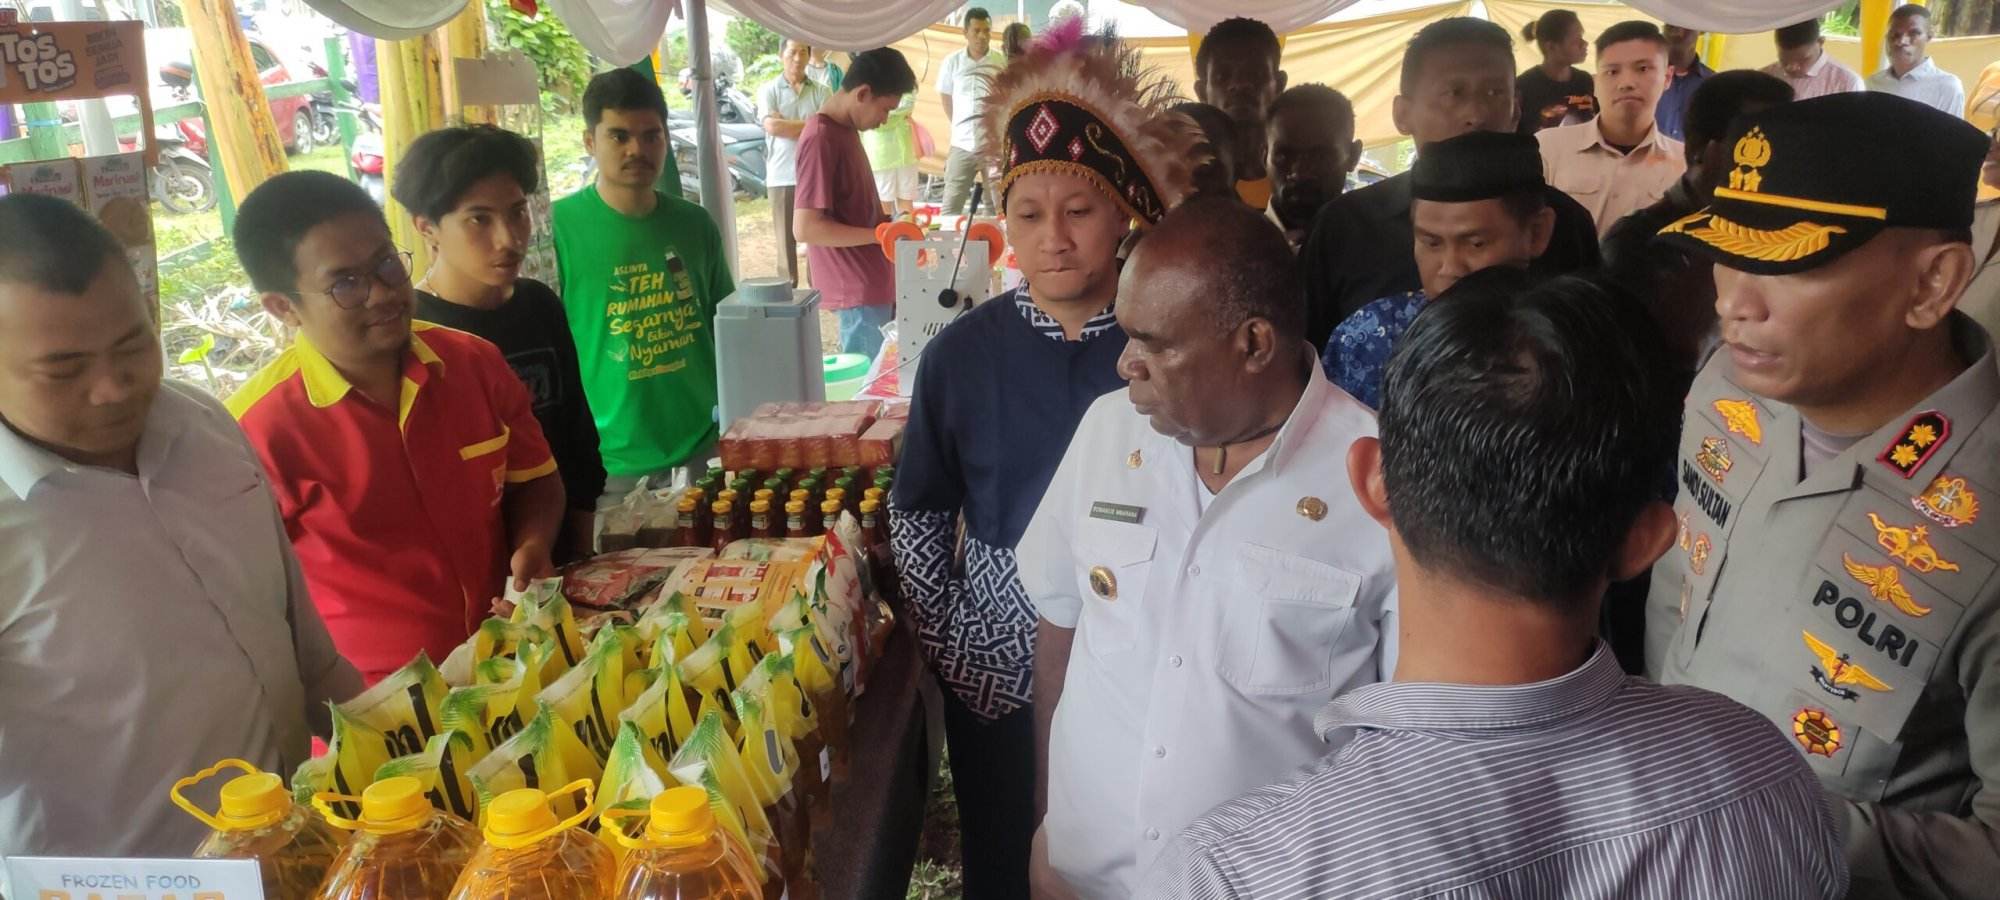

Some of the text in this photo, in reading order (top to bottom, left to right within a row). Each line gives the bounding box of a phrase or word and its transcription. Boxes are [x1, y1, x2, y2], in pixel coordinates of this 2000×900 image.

[0, 33, 57, 63] TOS
[18, 53, 76, 90] TOS
[629, 271, 665, 295] TEH
[606, 290, 674, 317] RUMAHAN
[609, 303, 697, 339] Segarnya
[629, 332, 697, 367] Nyaman
[1697, 481, 1732, 530] SULTAN
[1812, 579, 1919, 668] POLRI
[61, 873, 202, 889] FROZEN FOOD
